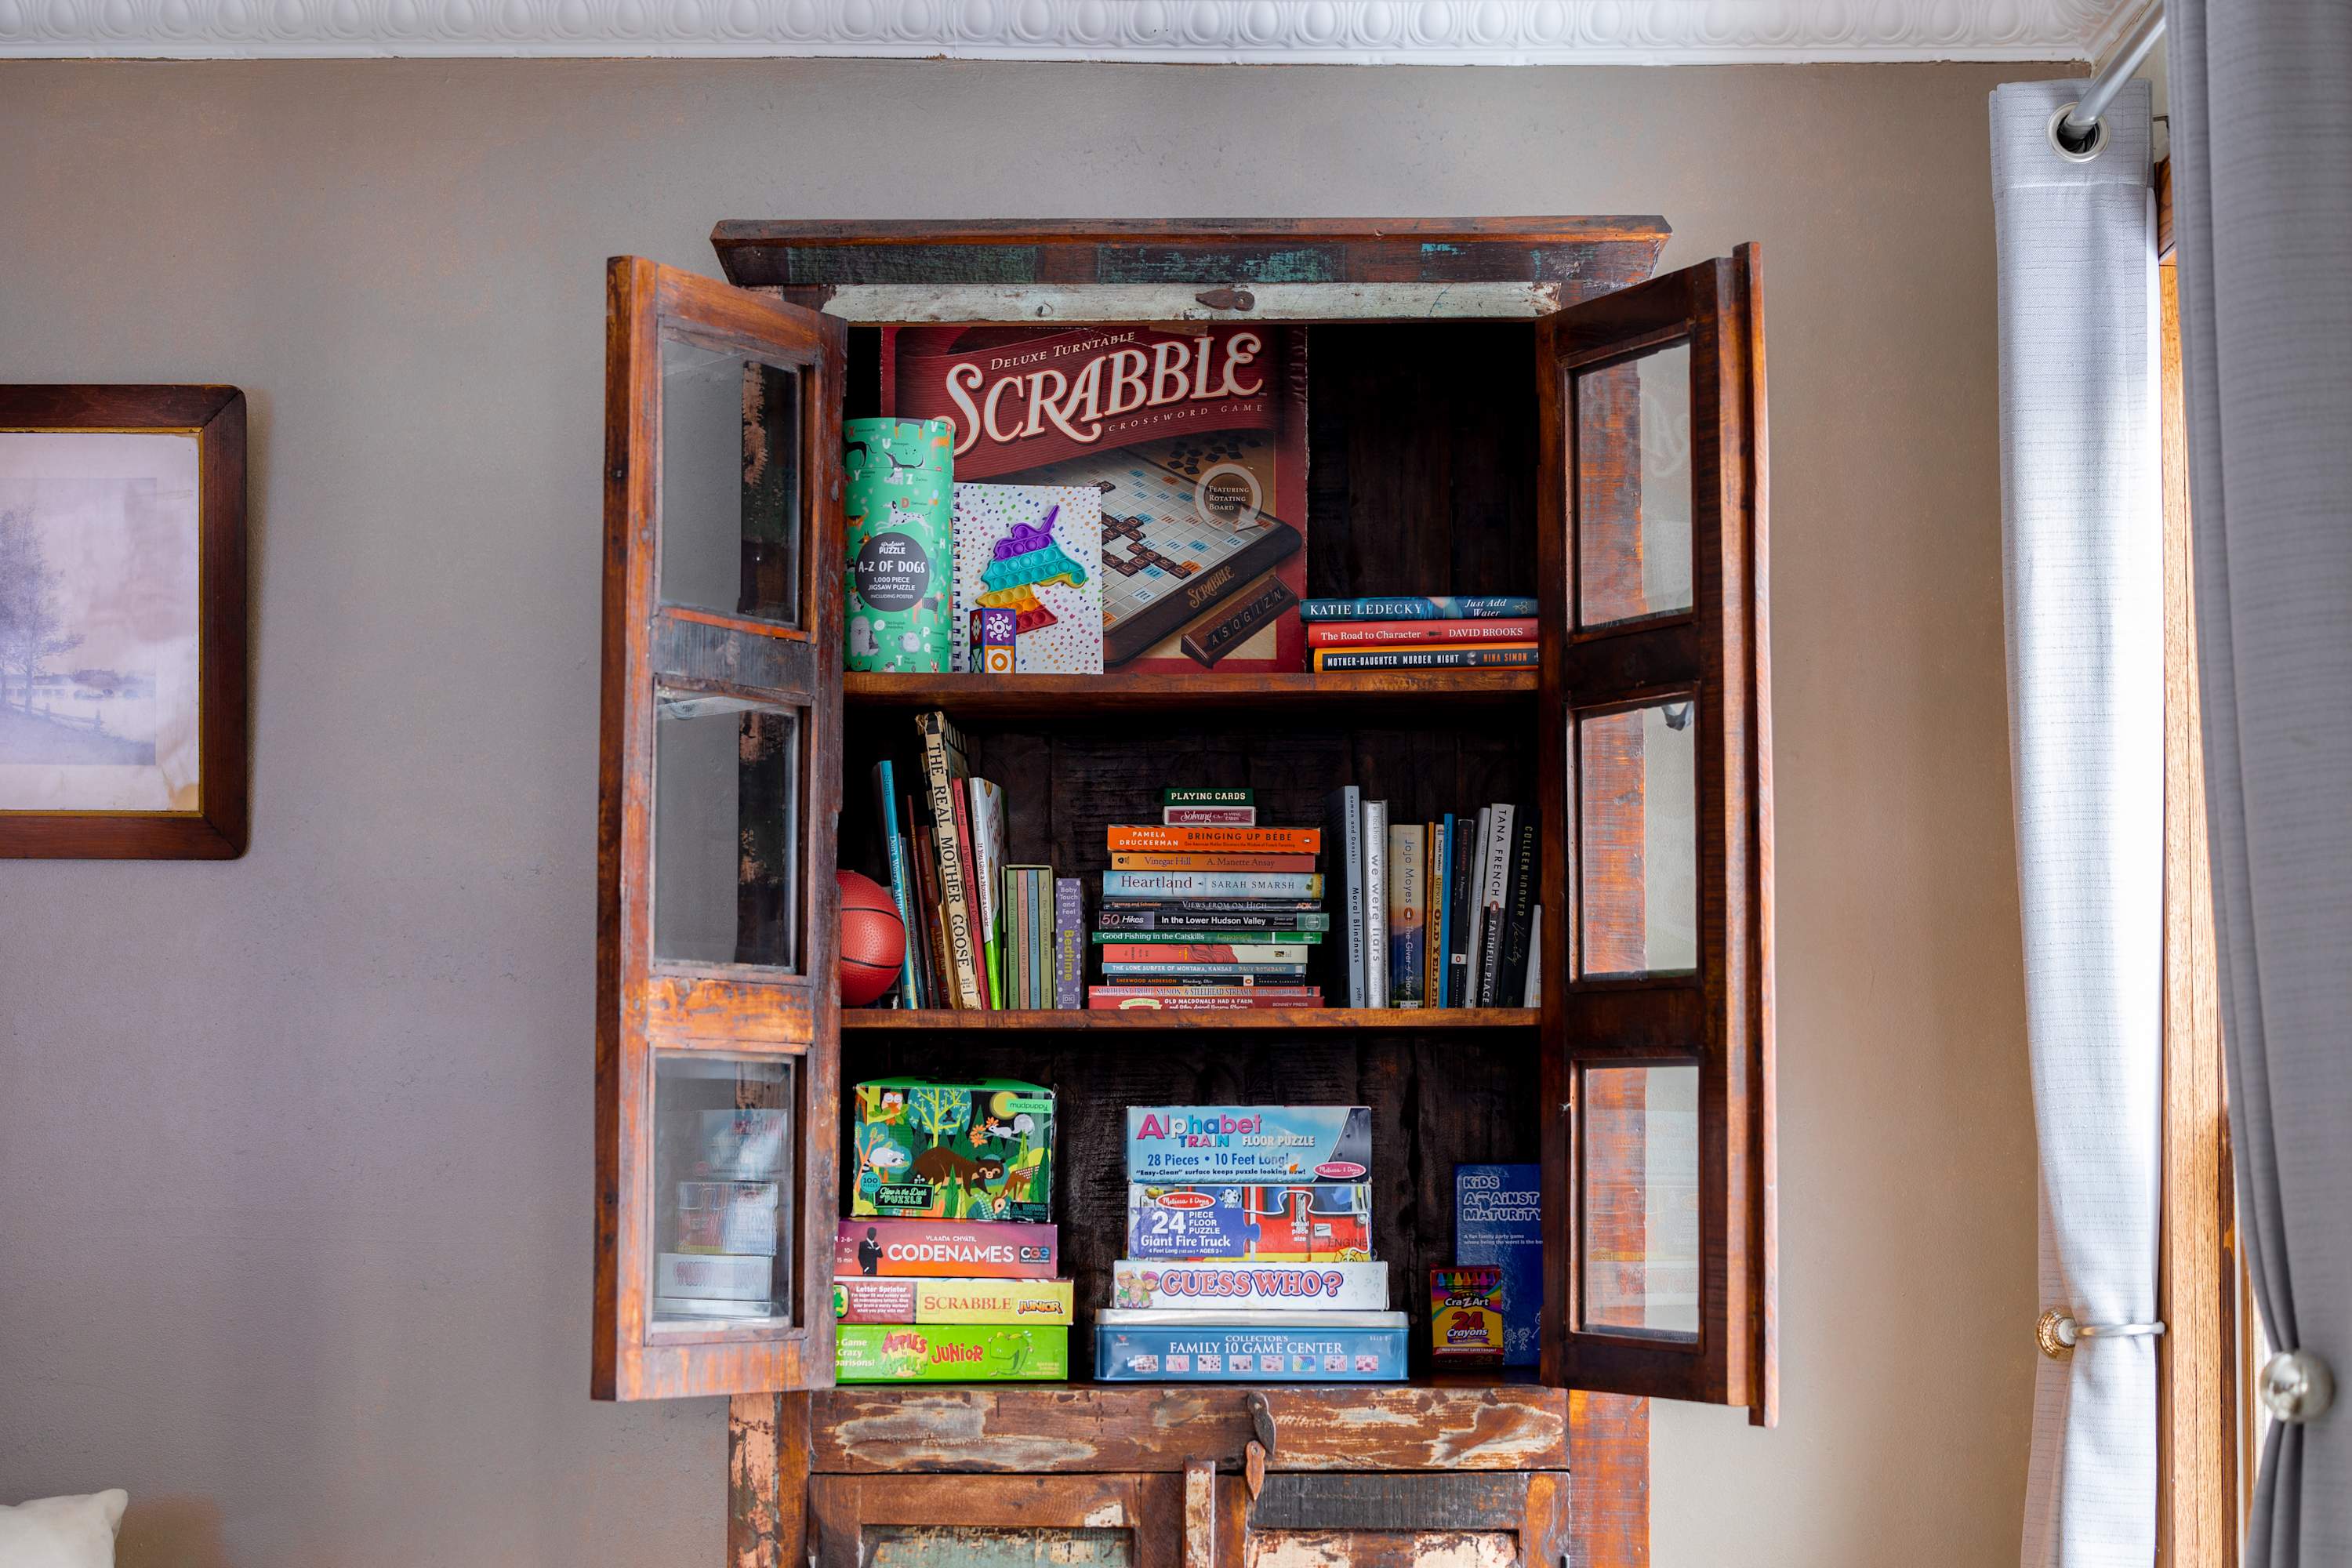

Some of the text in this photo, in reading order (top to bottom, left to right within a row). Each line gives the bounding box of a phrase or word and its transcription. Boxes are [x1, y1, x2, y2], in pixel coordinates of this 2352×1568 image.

[991, 332, 1135, 371] DELUXE TURNTABLE
[933, 332, 1263, 456] SCRABBLE
[1109, 404, 1263, 433] CROSSWORD GAME
[858, 561, 925, 573] A-Z OF DOGS
[1187, 564, 1236, 608] SCRABBLE
[1310, 604, 1422, 615] KATIE LEDECKY
[1465, 599, 1485, 608] Just
[1472, 608, 1501, 617] Water
[1320, 632, 1338, 641] The
[1341, 631, 1363, 641] Road
[1376, 630, 1421, 639] Character
[1449, 627, 1523, 637] DAVID BROOKS
[1327, 654, 1459, 666] MOTHER-DAUGHTER MURDER NIGHT
[1483, 652, 1527, 663] NINA SIMON
[928, 743, 943, 776] THE
[934, 786, 949, 827] REAL
[1180, 811, 1212, 823] Solvang
[1265, 832, 1292, 840] BÉBÉ
[1403, 840, 1414, 863] Jojo
[1491, 810, 1506, 896] TANA FRENCH
[1521, 826, 1533, 870] COLLEEN
[1145, 856, 1191, 866] Vinegar Hill
[1218, 858, 1250, 866] Manette
[1251, 858, 1275, 867] Ansay
[941, 837, 961, 904] MOTHER
[1121, 876, 1192, 888] Heartland
[1403, 868, 1414, 904] Moyes
[1060, 887, 1077, 895] Baby
[1371, 855, 1382, 962] we were liars
[1102, 914, 1120, 925] 50
[1243, 917, 1266, 926] Valley
[1433, 909, 1442, 942] OLD
[951, 914, 969, 968] GOOSE
[1506, 922, 1525, 966] Verity
[1064, 929, 1075, 980] Bedtime
[1482, 920, 1497, 1003] FAITHFUL PLACE
[1431, 946, 1441, 1008] YELLER
[1010, 1102, 1048, 1112] mudpuppy
[1136, 1114, 1262, 1140] Alphabet
[1178, 1135, 1315, 1148] TRAIN FLOOR PUZZLE
[1148, 1153, 1289, 1167] 28 Pieces 10 Feet Long!
[884, 1196, 922, 1204] PUZZLE
[1163, 1196, 1189, 1205] Melissa
[1194, 1198, 1211, 1207] Doug
[1151, 1212, 1186, 1234] 24
[1141, 1235, 1230, 1247] Giant Fire Truck
[1328, 1238, 1367, 1247] ENGINE
[887, 1243, 1014, 1262] CODENAMES
[1160, 1270, 1343, 1297] GUESS WHO?
[924, 1296, 1063, 1315] SCRABBLE JUNIOR
[1452, 1311, 1484, 1330] 24
[1447, 1329, 1488, 1338] Crayons
[841, 1338, 867, 1347] Game
[1170, 1342, 1343, 1354] FAMILY 10 GAME CENTER
[838, 1348, 862, 1358] Crazy
